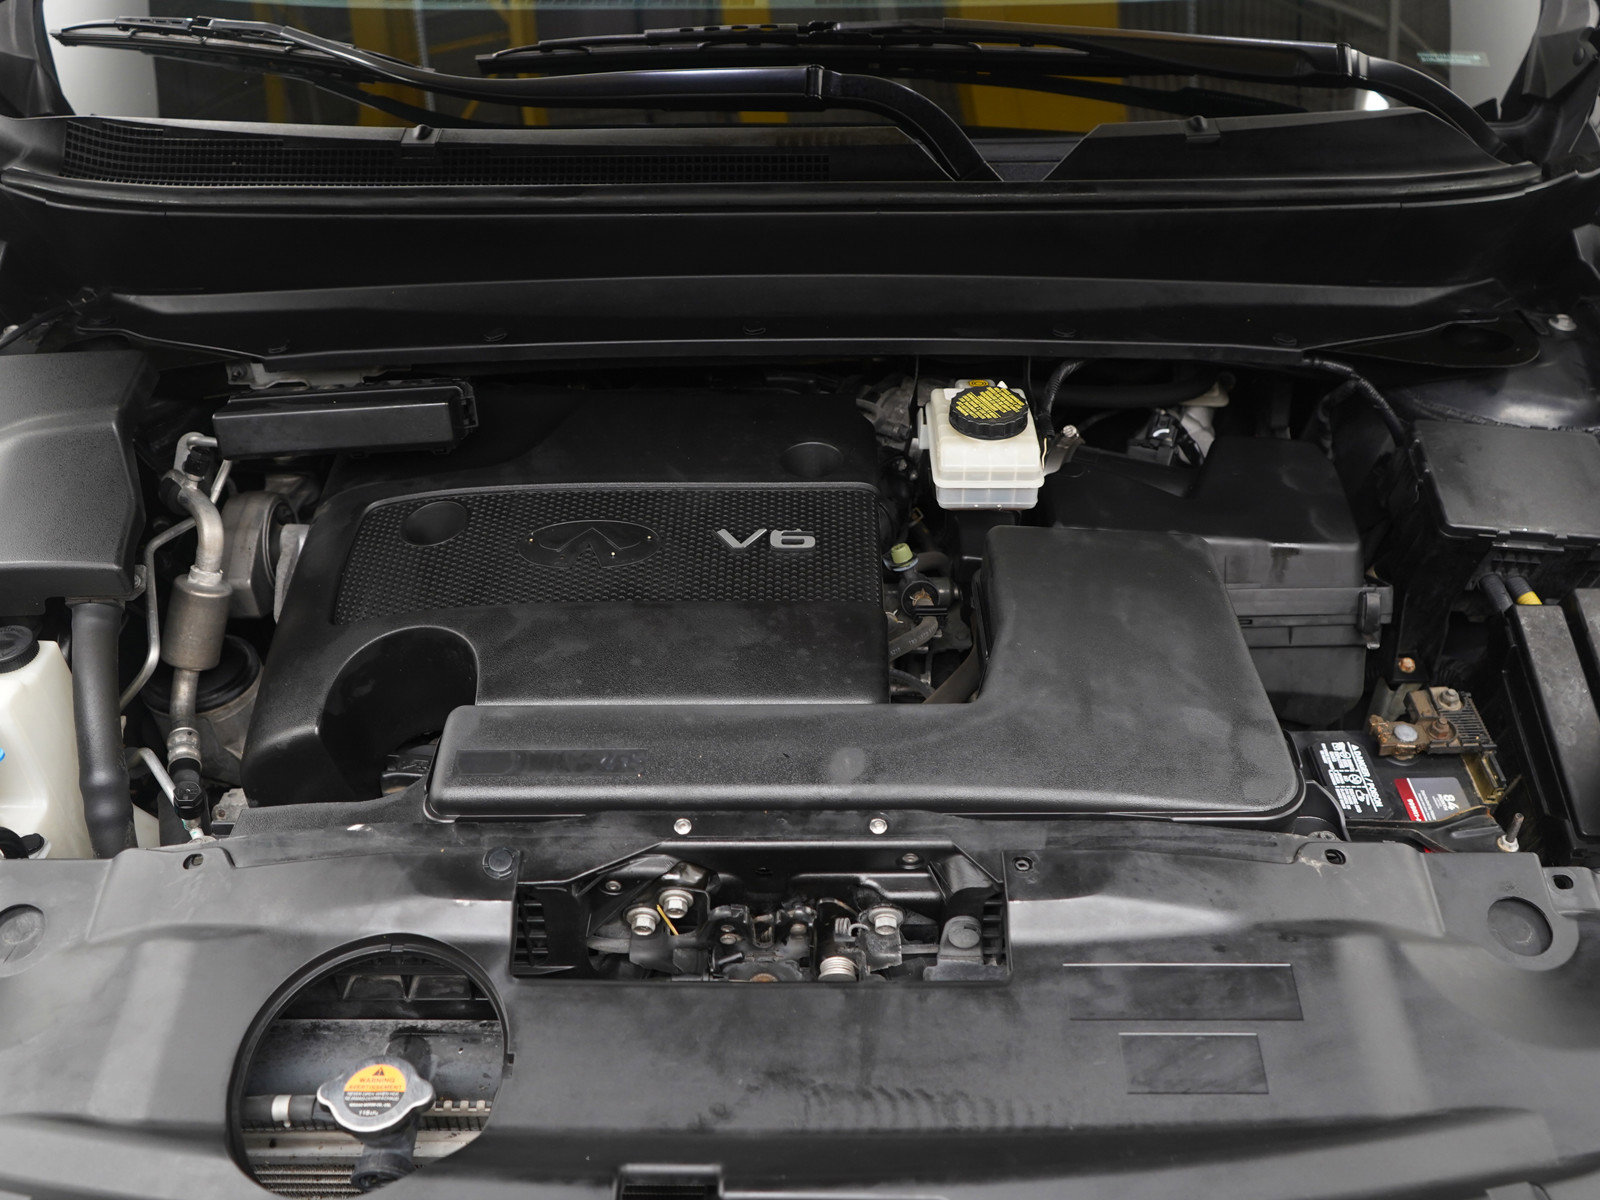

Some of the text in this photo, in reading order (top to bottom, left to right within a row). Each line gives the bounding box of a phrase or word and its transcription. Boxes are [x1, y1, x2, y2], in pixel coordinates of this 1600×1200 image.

[716, 528, 816, 549] V6
[1353, 750, 1371, 777] DANGER
[1366, 782, 1384, 807] POISON
[1442, 793, 1460, 811] 84
